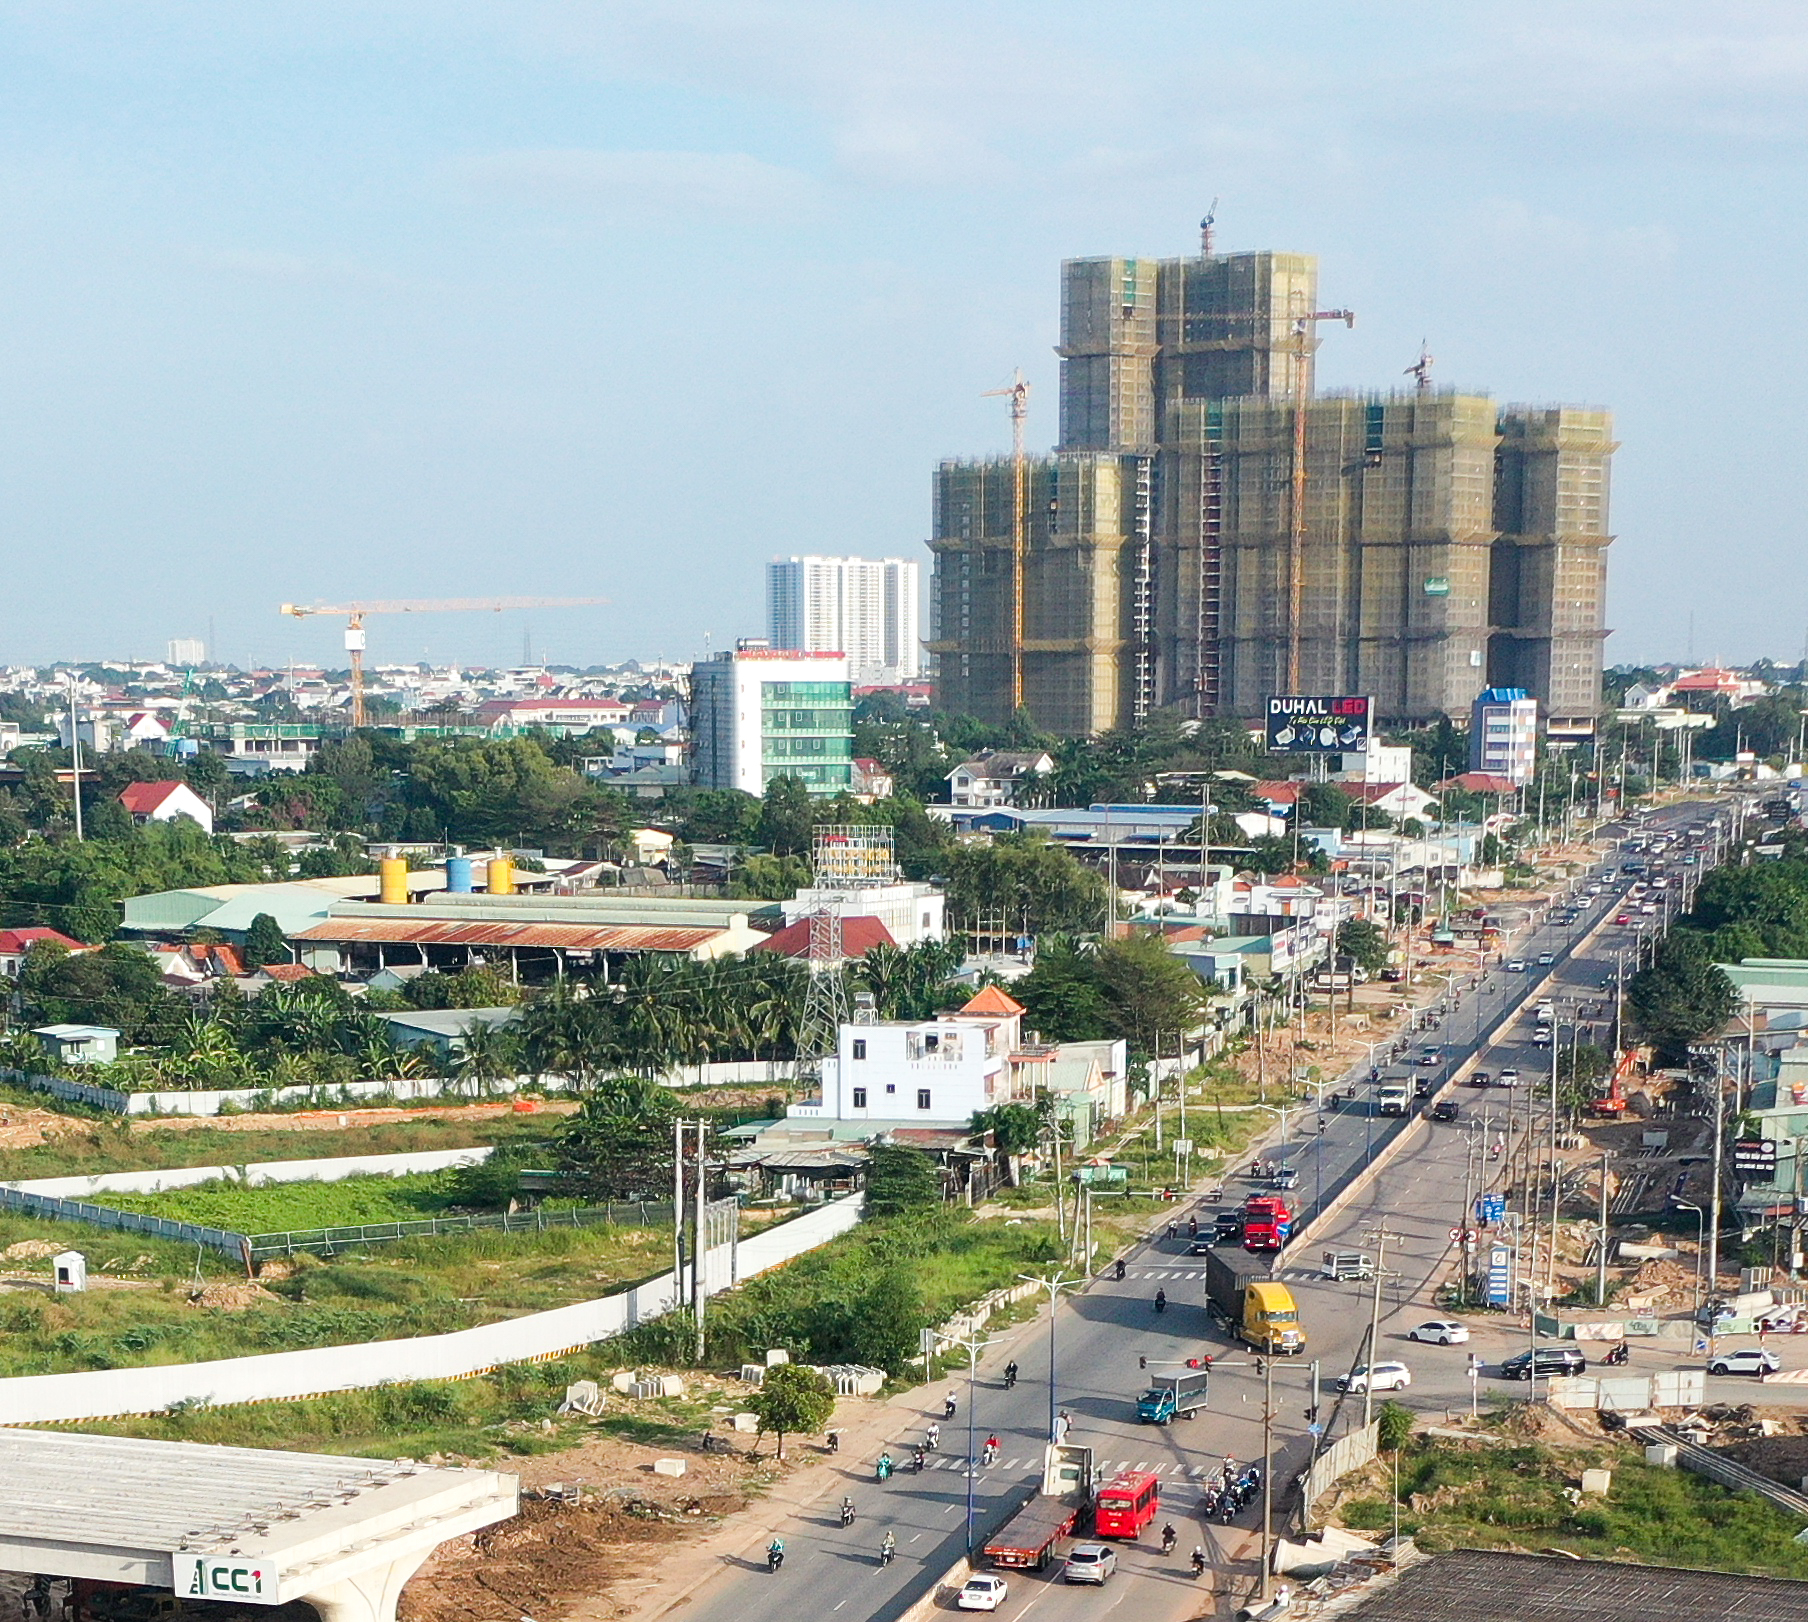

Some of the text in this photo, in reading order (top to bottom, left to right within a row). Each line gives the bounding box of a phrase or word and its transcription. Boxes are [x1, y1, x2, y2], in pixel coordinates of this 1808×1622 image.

[1271, 698, 1366, 714] DUHAL LED
[211, 1566, 262, 1594] CC1
